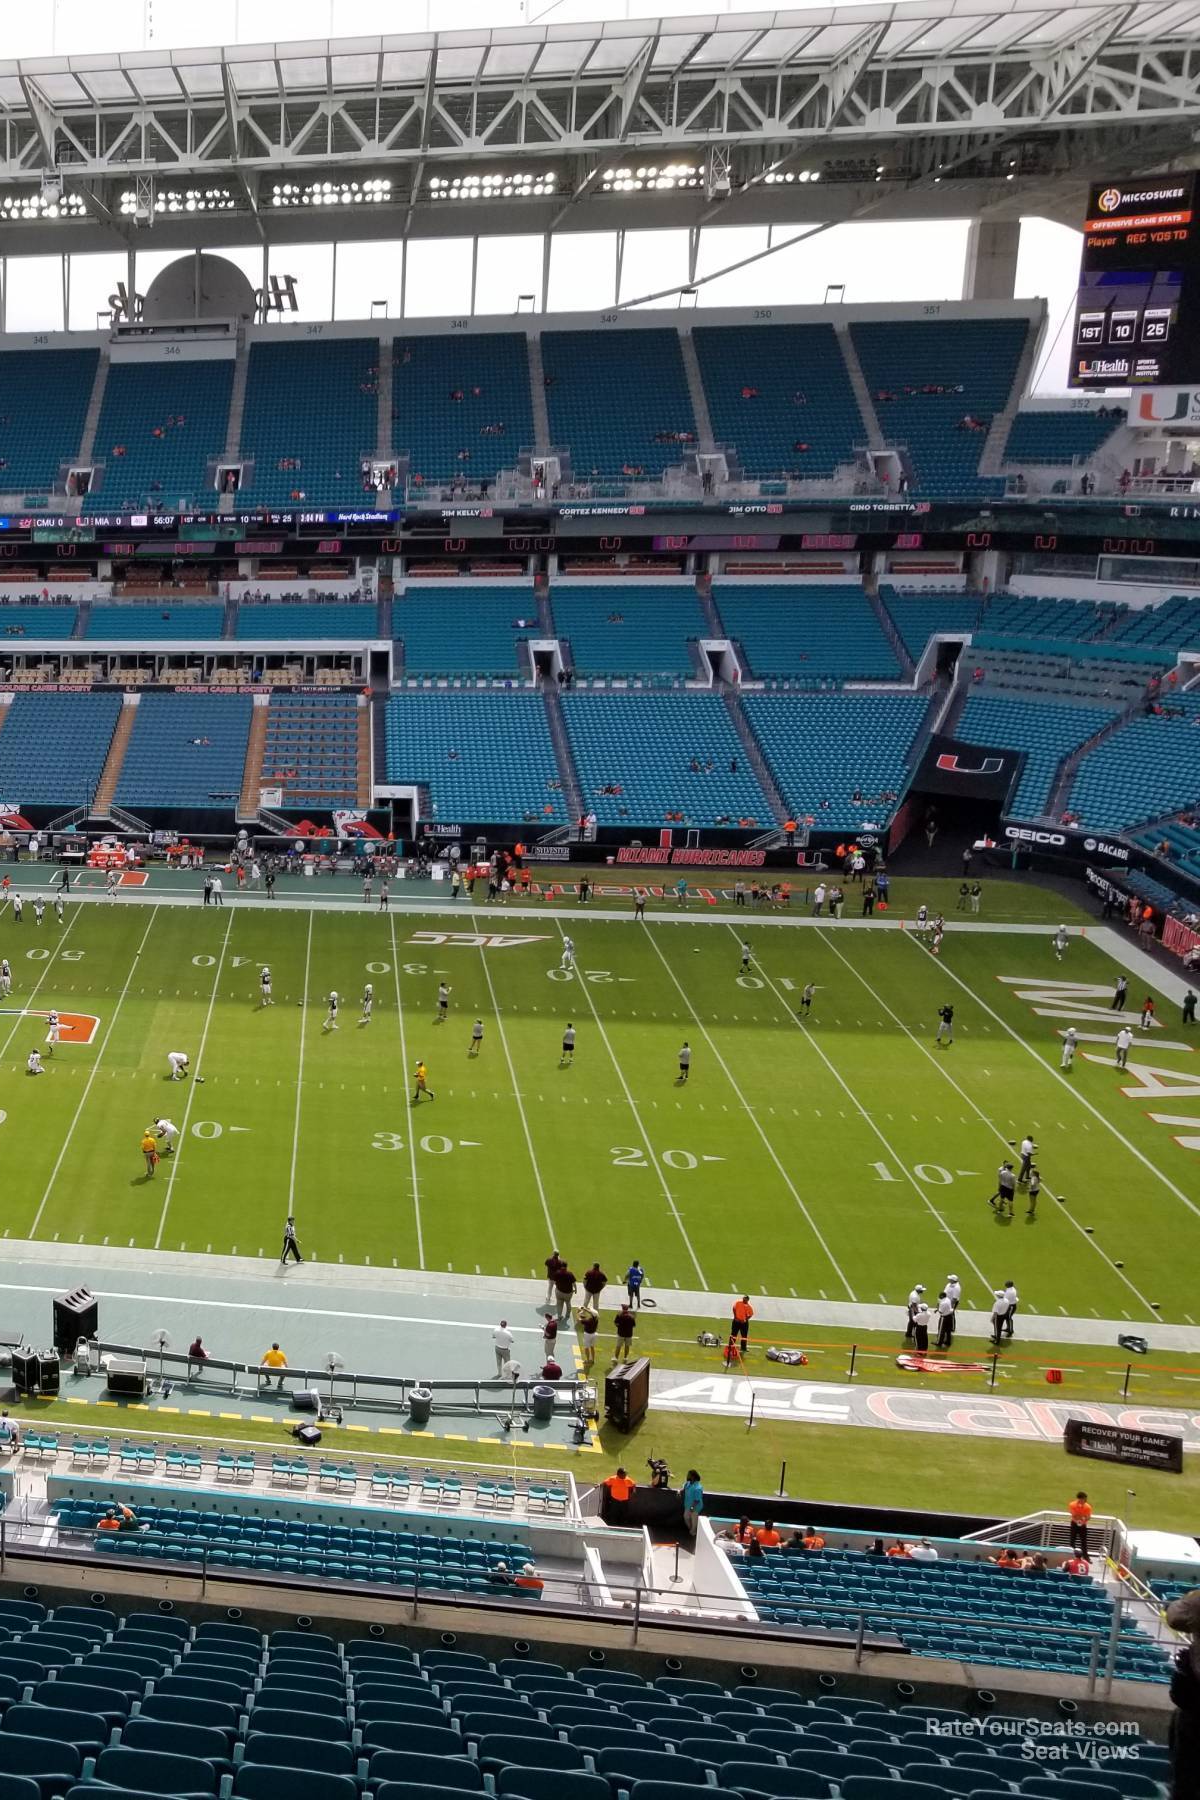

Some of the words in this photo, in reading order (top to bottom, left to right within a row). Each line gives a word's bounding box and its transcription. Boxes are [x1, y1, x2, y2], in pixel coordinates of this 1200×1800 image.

[1121, 188, 1184, 203] MICCOSUKEE
[1092, 219, 1133, 229] OFFENSIVE
[1134, 217, 1157, 225] GAME
[1158, 214, 1182, 222] STATS
[1088, 237, 1117, 247] Player
[1126, 233, 1147, 244] REC
[1174, 230, 1188, 239] TD
[753, 309, 772, 319] 350
[923, 305, 940, 315] 351
[306, 326, 323, 335] 347
[1081, 327, 1101, 338] 1ST
[1116, 325, 1130, 337] 10
[33, 336, 48, 344] 345
[164, 346, 181, 355] 346
[36, 519, 55, 527] CMU
[240, 515, 249, 523] 10
[1005, 827, 1066, 845] GEICO
[617, 848, 670, 863] MIAMI
[671, 849, 766, 866] HURRICANES
[371, 1131, 454, 1154] 30
[609, 1146, 698, 1170] 20
[867, 1161, 955, 1185] 10
[650, 1377, 857, 1415] ACC
[1081, 1426, 1118, 1437] RECOVER
[1119, 1432, 1141, 1442] YOUR
[1121, 1445, 1142, 1454] SPORTS
[1142, 1449, 1169, 1459] MEDICINE
